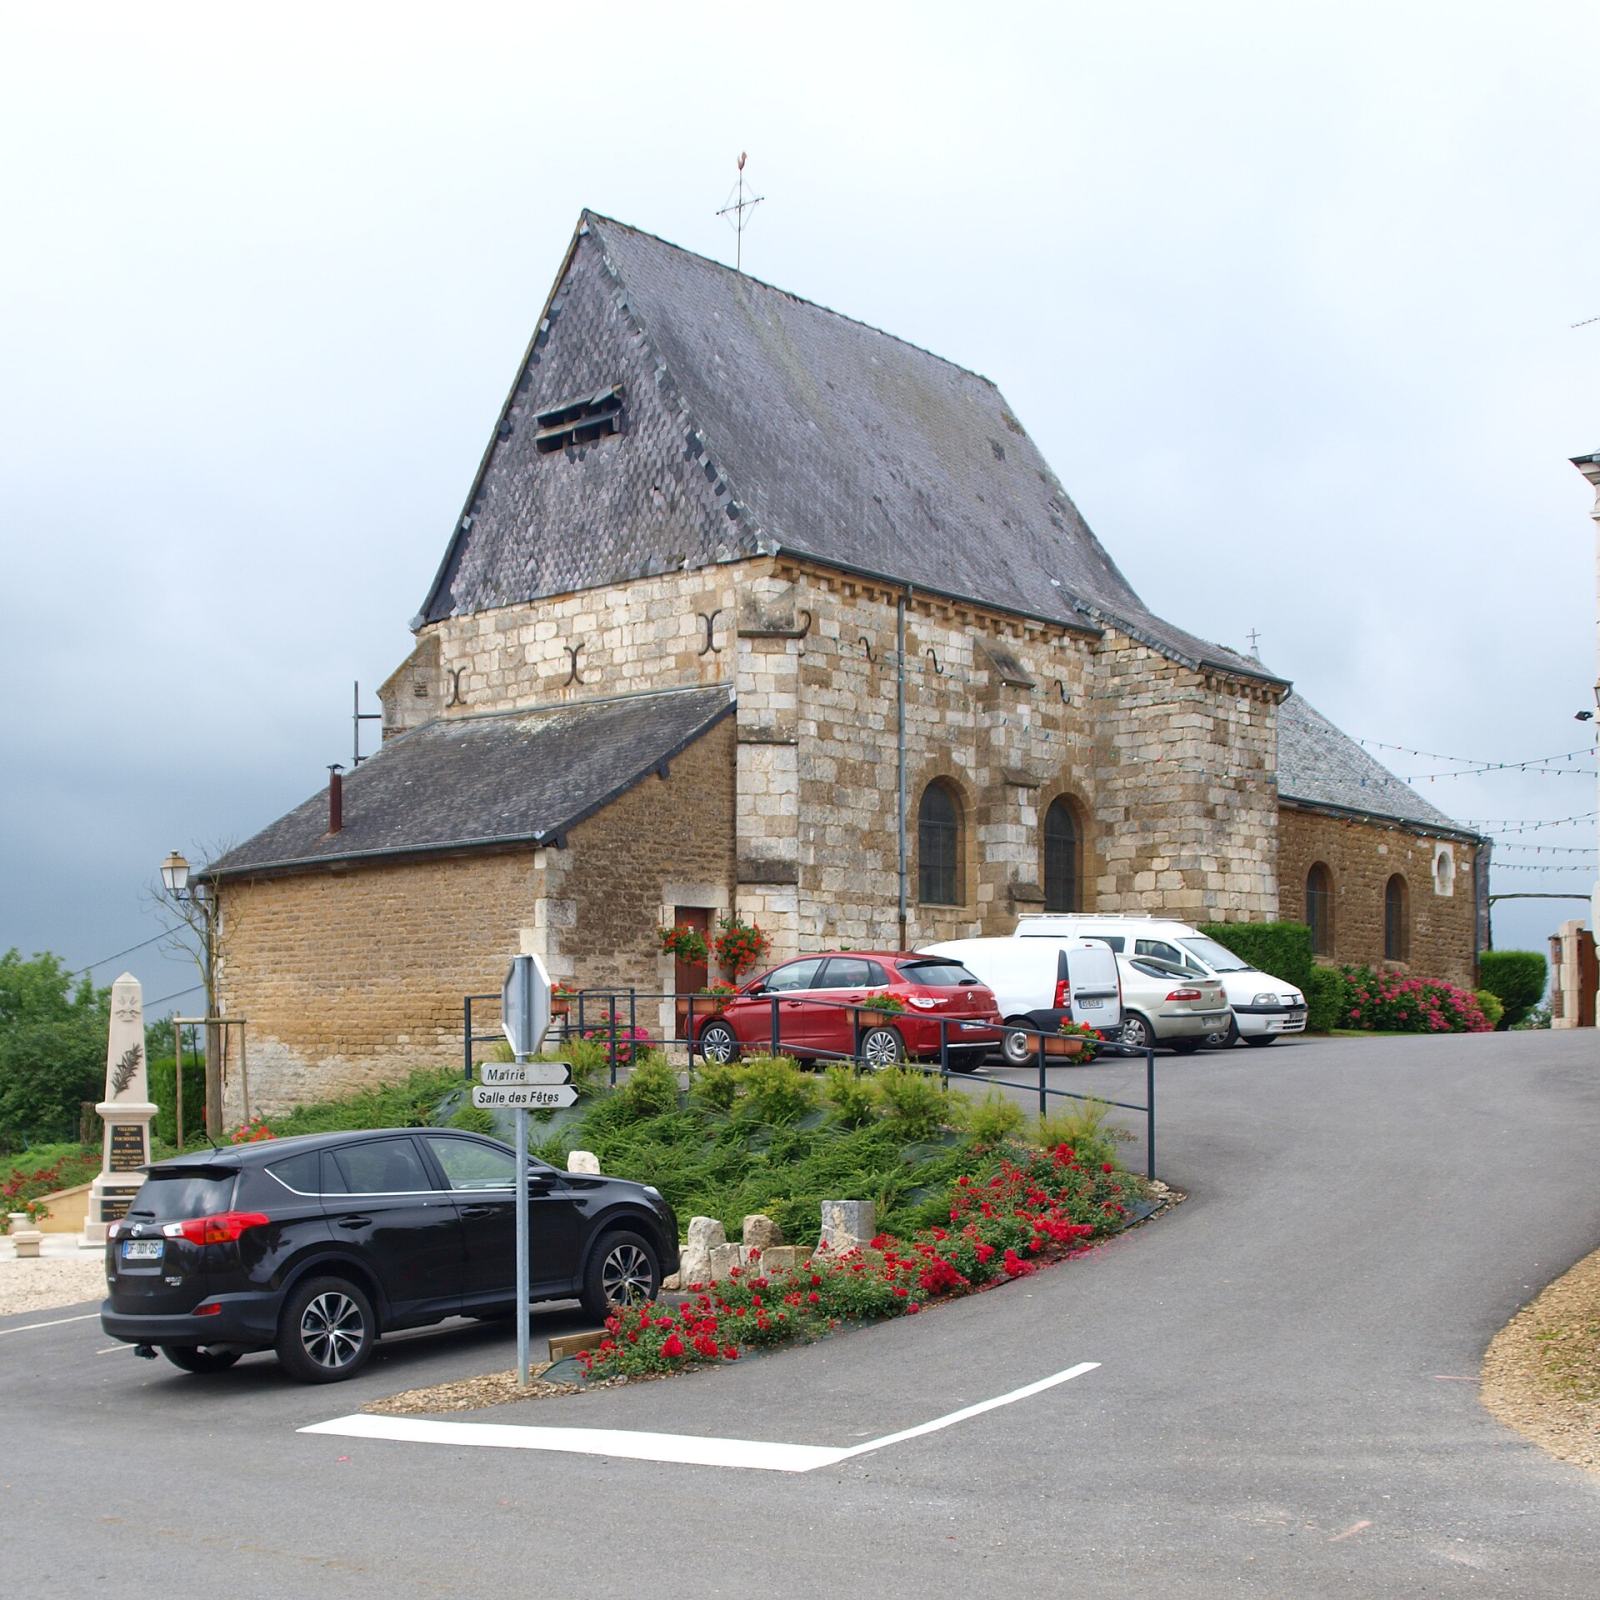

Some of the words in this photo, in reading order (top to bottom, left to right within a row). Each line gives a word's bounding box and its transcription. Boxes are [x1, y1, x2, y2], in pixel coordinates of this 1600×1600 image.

[487, 1069, 526, 1081] Mairie
[478, 1092, 505, 1104] Salle
[508, 1092, 527, 1103] des
[530, 1091, 559, 1103] Fêtes
